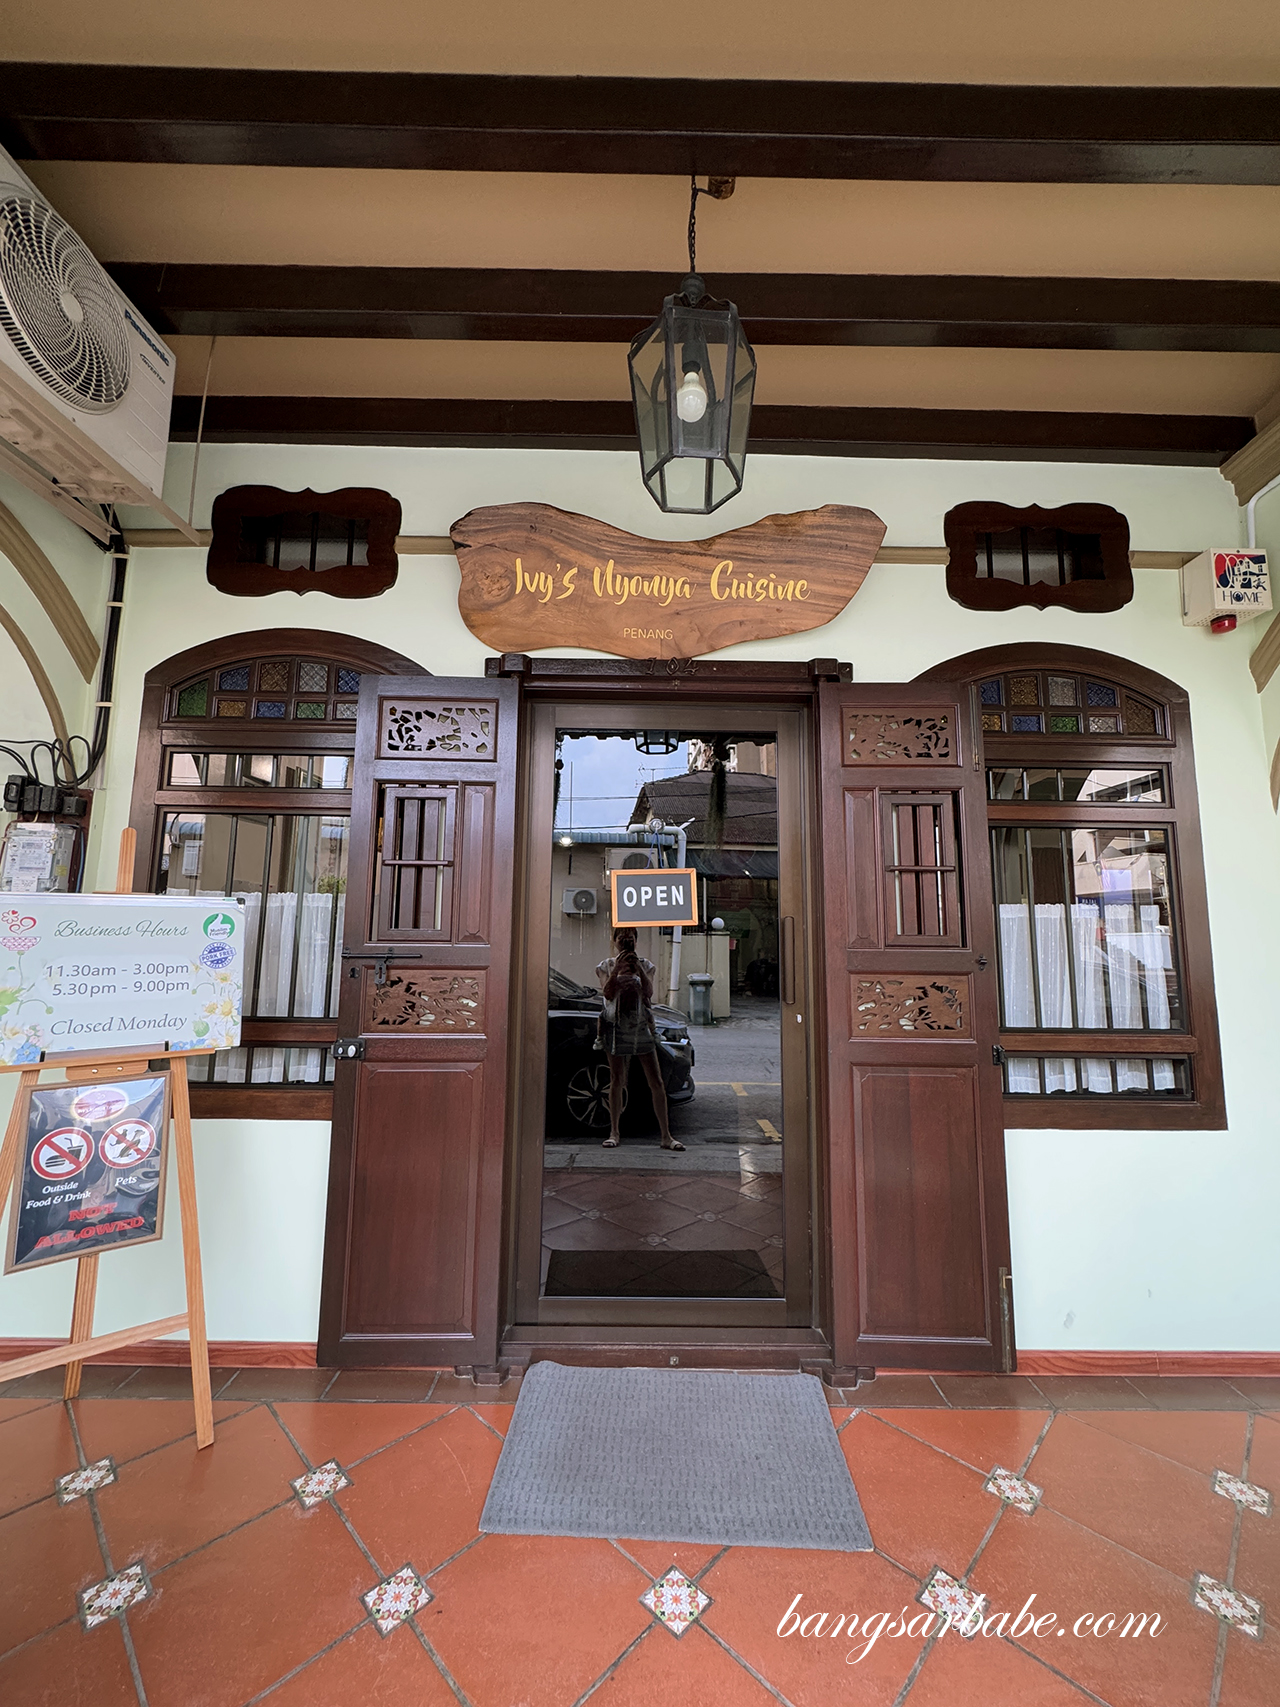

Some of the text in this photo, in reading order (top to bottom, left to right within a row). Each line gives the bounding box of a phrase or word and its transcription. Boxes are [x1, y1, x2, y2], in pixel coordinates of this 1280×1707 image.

[124, 309, 169, 367] Panasonic
[515, 558, 813, 607] Ivy's Nyonya Cuisine
[1222, 590, 1263, 605] HOME
[623, 628, 673, 640] PENANG
[623, 885, 684, 907] OPEN
[54, 919, 189, 938] Business Hours
[201, 949, 234, 962] PORK FREE
[46, 964, 116, 978] 11.30am
[133, 962, 189, 977] 3.00pm
[133, 980, 190, 994] 9.00pm
[50, 1013, 187, 1035] Closed Monday
[42, 1181, 79, 1194] Outside
[114, 1176, 138, 1187] Pets
[25, 1190, 91, 1209] Food & Drink
[68, 1202, 118, 1222] NOT
[34, 1216, 145, 1249] ALLOWED
